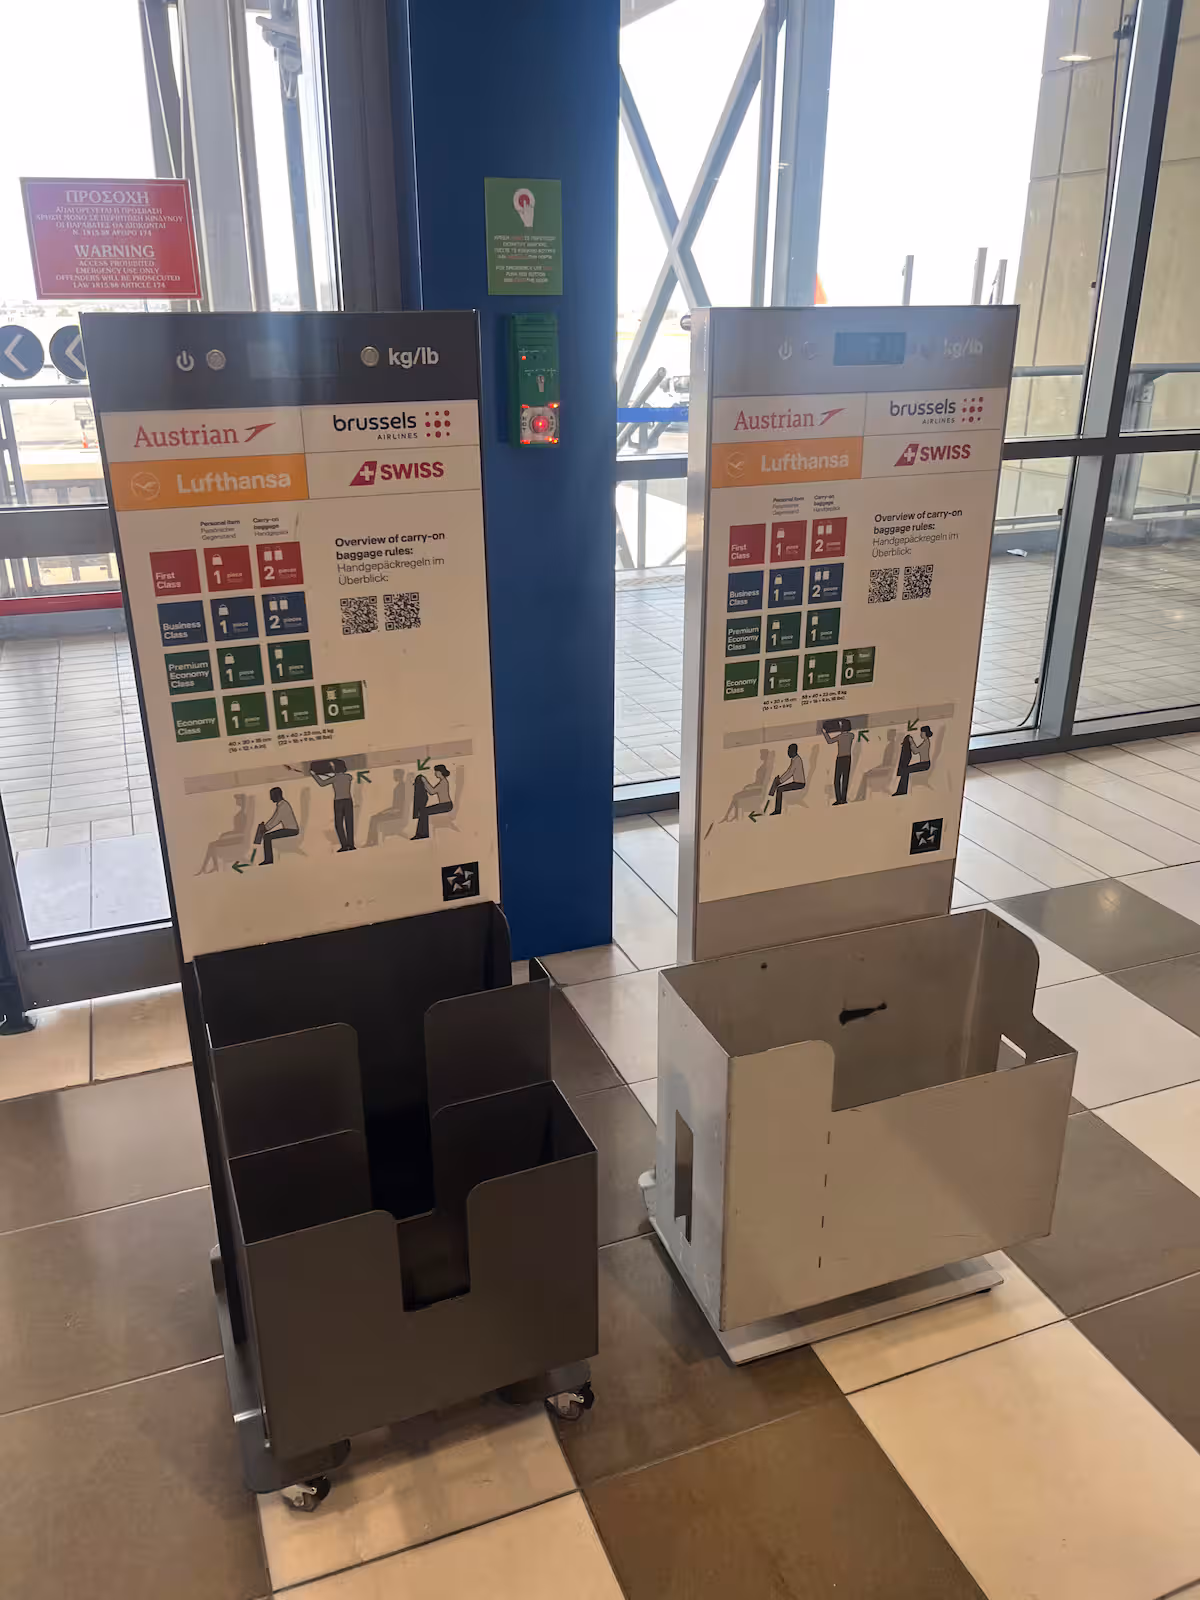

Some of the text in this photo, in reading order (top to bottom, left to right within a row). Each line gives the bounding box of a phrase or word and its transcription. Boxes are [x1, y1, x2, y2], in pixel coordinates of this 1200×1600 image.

[65, 190, 149, 204] ΠΡΟΣΟΧΗ
[74, 244, 155, 258] WARNING
[943, 337, 983, 359] kg/lb
[388, 346, 439, 369] kg/lb
[890, 398, 956, 417] brussels
[333, 411, 417, 432] brussels
[733, 409, 814, 431] Austrian
[922, 417, 956, 425] AIRLINES
[133, 424, 239, 448] Austrian
[377, 432, 418, 440] AIRLINES
[919, 444, 971, 461] SWISS
[760, 452, 849, 472] Lufthansa
[380, 461, 444, 480] SWISS
[176, 470, 291, 494] Lufthansa
[874, 509, 963, 523] Overview of carry-on
[873, 523, 936, 535] baggage rules:
[335, 532, 445, 547] Overview of carry-on
[814, 539, 824, 553] 2
[872, 532, 959, 546] Handgepäckregeln im
[336, 547, 414, 561] baggage rules:
[731, 552, 751, 560] Class
[775, 542, 782, 556] 1
[871, 547, 912, 558] Überblick:
[337, 557, 445, 573] Handgepäckregeln im
[155, 572, 176, 580] First
[213, 570, 222, 584] 1
[263, 565, 275, 580] 2
[156, 580, 182, 589] Class
[338, 574, 389, 586] Überblick:
[729, 589, 760, 599] Business
[773, 588, 780, 602] 1
[811, 584, 821, 598] 2
[729, 599, 749, 607] Class
[162, 621, 202, 632] Business
[219, 620, 228, 634] 1
[269, 615, 281, 630] 2
[164, 631, 189, 640] Class
[727, 626, 760, 636] Premium
[810, 629, 817, 642] 1
[727, 634, 760, 644] Economy
[771, 633, 777, 646] 1
[727, 643, 747, 651] Class
[168, 661, 209, 672] Premium
[276, 663, 284, 677] 1
[844, 667, 854, 680] 0
[169, 669, 210, 680] Economy
[226, 668, 234, 682] 1
[807, 672, 814, 684] 1
[171, 679, 195, 689] Class
[725, 677, 757, 688] Economy
[768, 677, 775, 689] 1
[725, 687, 745, 695] Class
[281, 709, 289, 723] 1
[328, 703, 339, 717] 0
[176, 716, 216, 727] Economy
[232, 715, 240, 729] 1
[178, 727, 202, 736] Class
